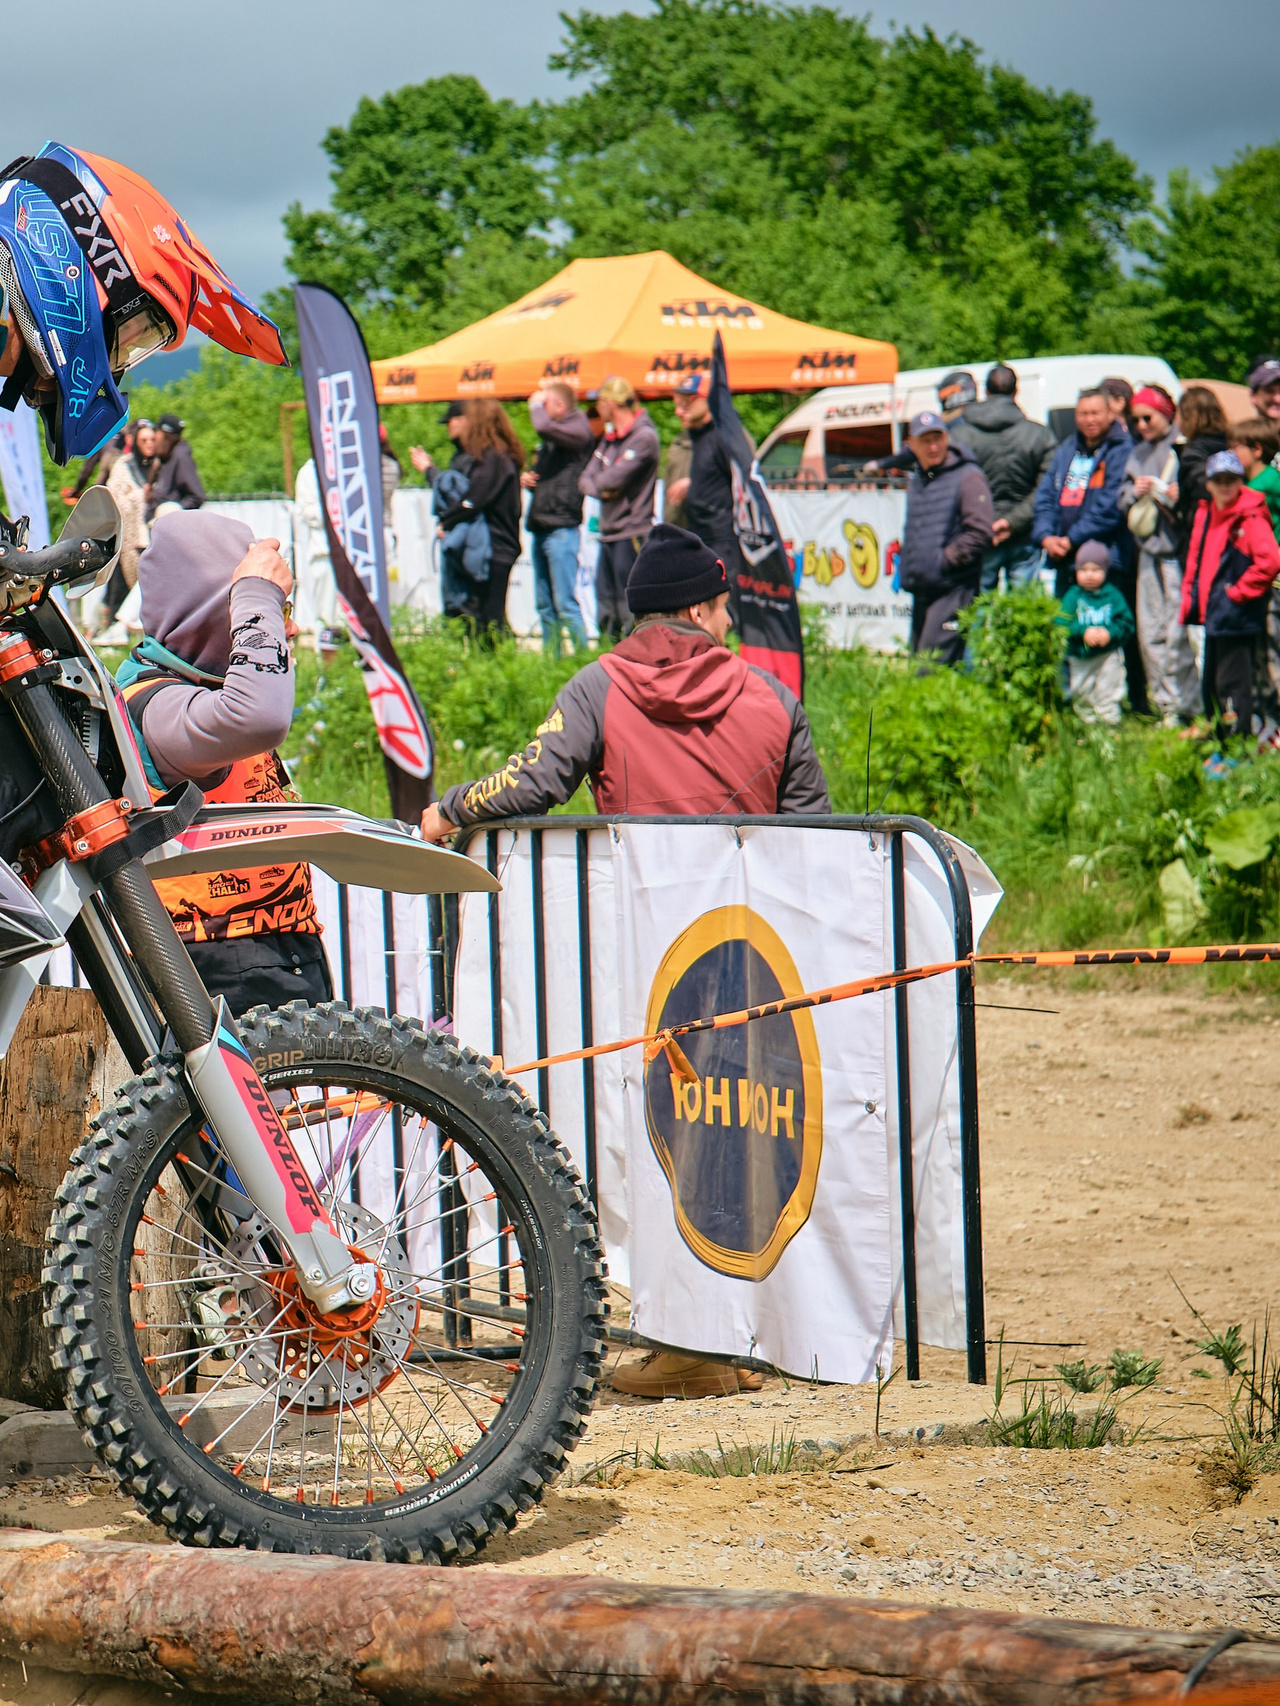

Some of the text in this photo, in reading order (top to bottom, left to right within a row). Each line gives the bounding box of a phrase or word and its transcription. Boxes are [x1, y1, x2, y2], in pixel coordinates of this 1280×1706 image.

[60, 192, 131, 289] FXR
[210, 823, 288, 842] DUNLOP
[241, 1076, 321, 1218] DUNLOP
